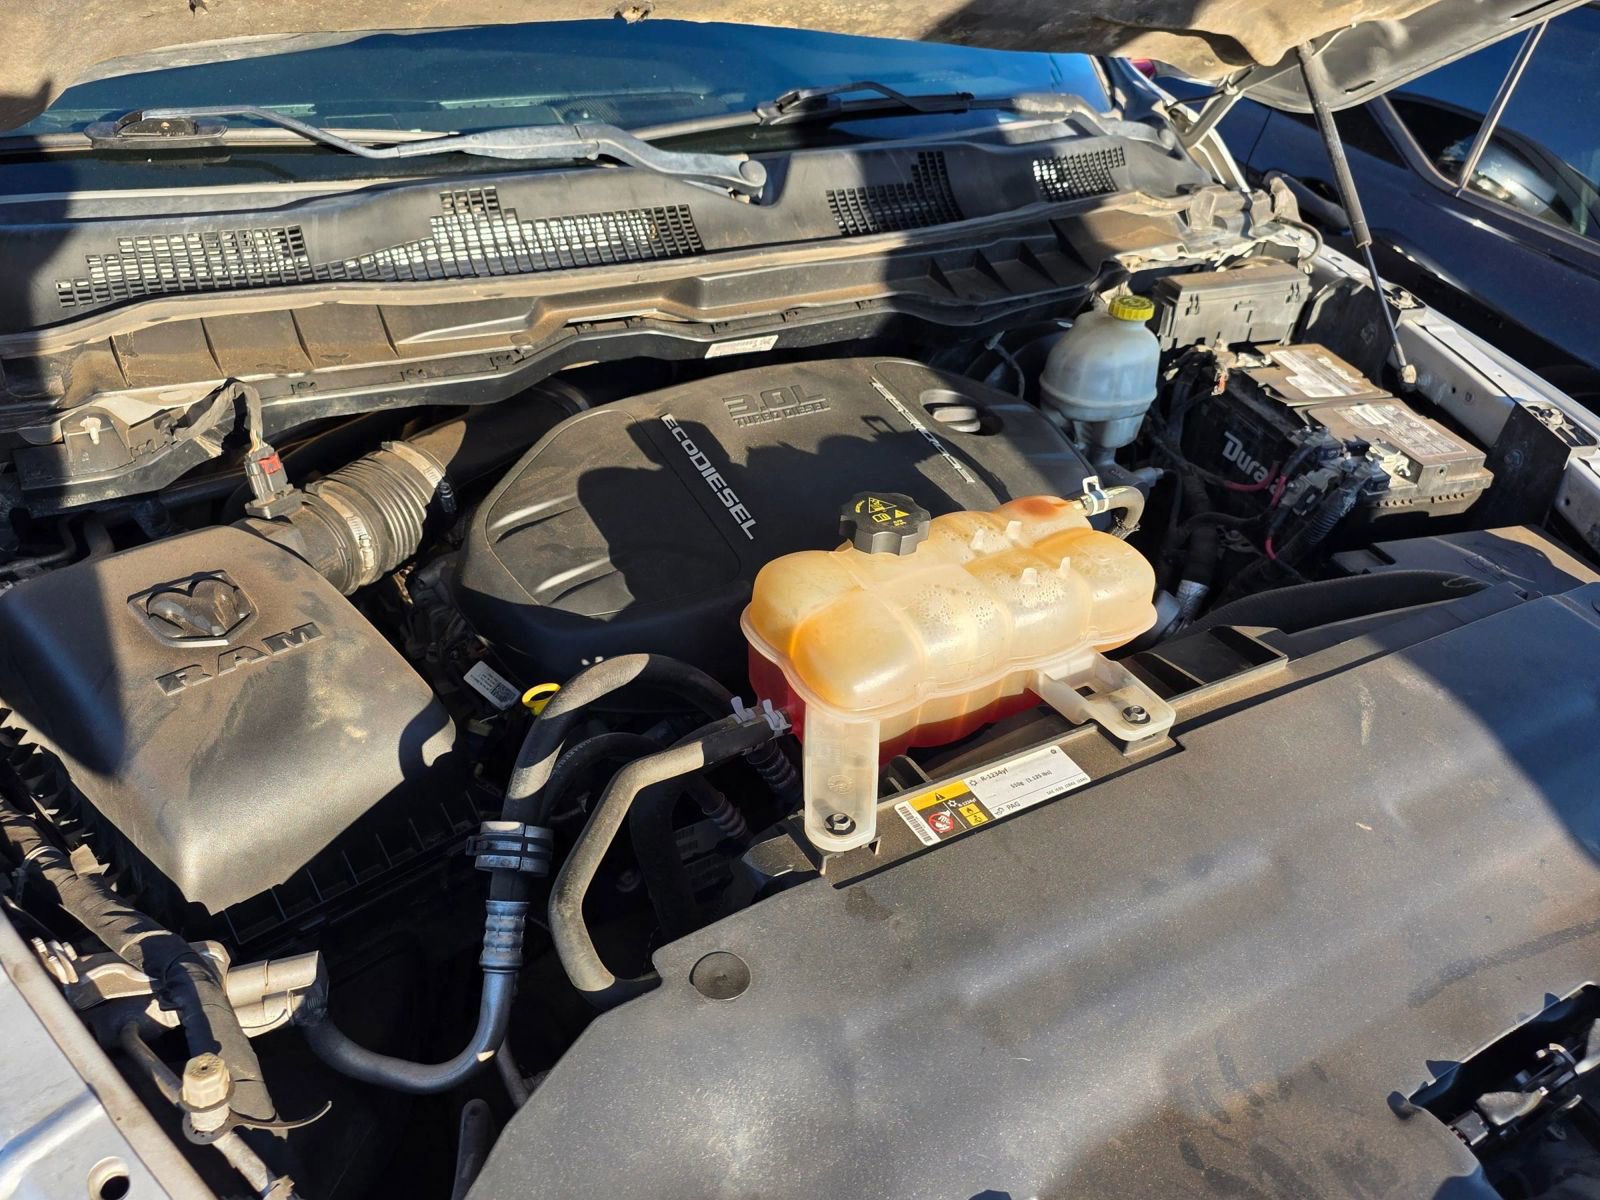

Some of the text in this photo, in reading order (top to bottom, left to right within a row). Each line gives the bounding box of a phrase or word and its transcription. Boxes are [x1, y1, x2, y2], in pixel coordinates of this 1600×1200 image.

[732, 402, 831, 428] TURBO DIESEL
[659, 413, 756, 541] ECODIESEL
[1222, 431, 1285, 495] Dura
[154, 621, 325, 697] RAM
[1006, 801, 1020, 811] PAG
